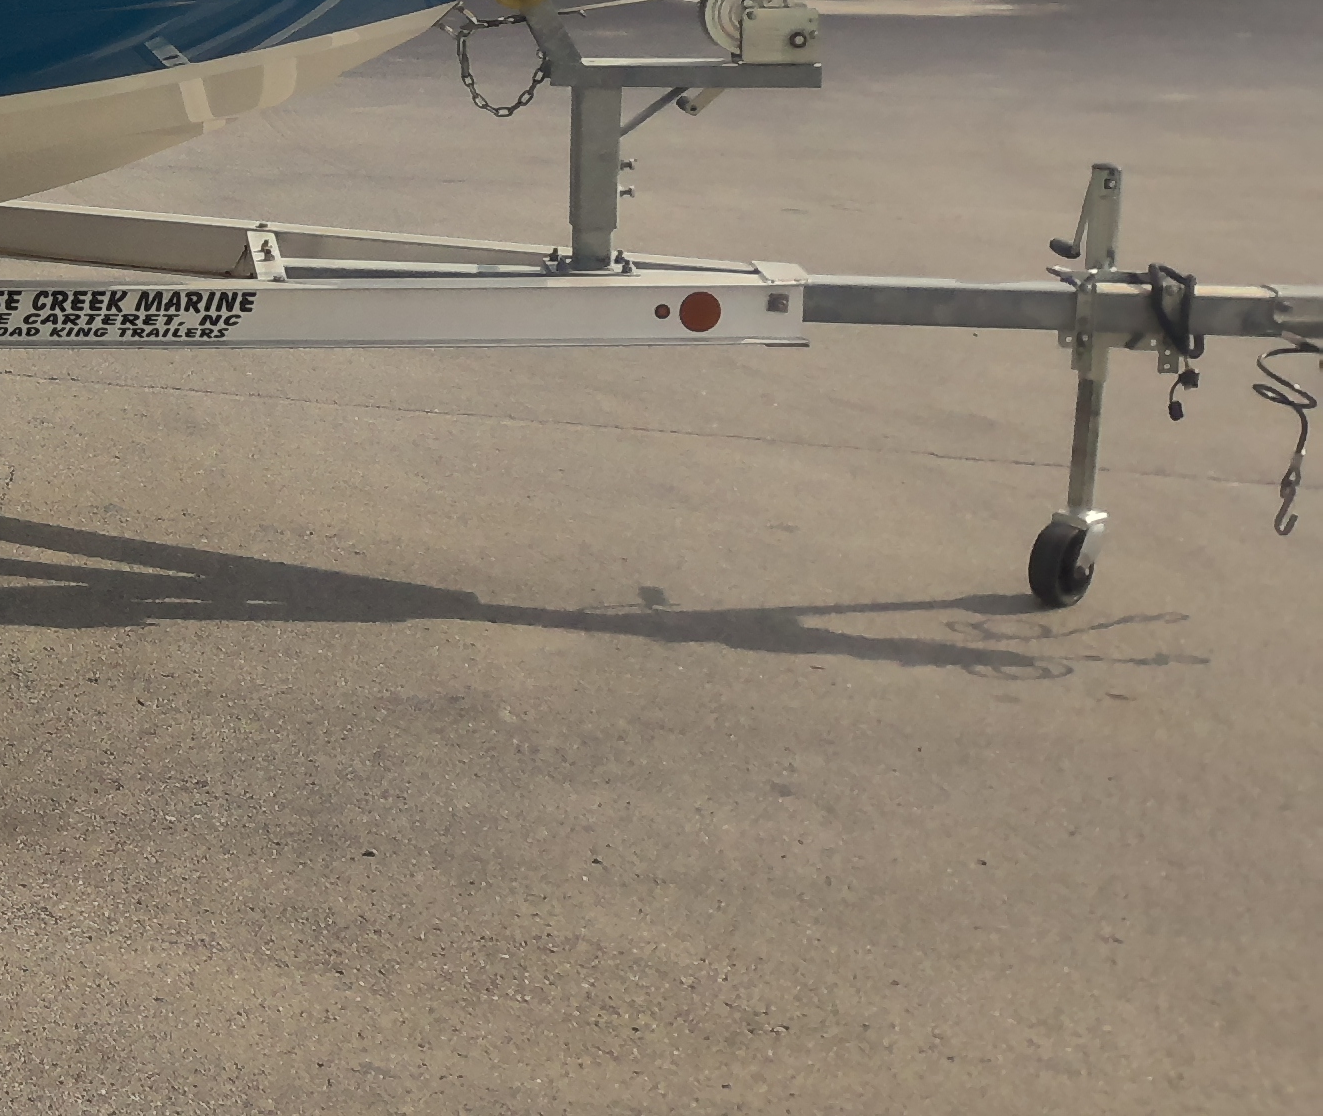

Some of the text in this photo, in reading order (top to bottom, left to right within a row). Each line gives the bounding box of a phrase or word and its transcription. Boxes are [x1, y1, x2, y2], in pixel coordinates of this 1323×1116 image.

[31, 290, 128, 313] CREEK
[134, 290, 257, 314] MARINE
[22, 312, 186, 327] CARTERET,
[199, 314, 243, 327] NC
[48, 326, 109, 338] KING
[117, 327, 230, 339] TRAILERS
